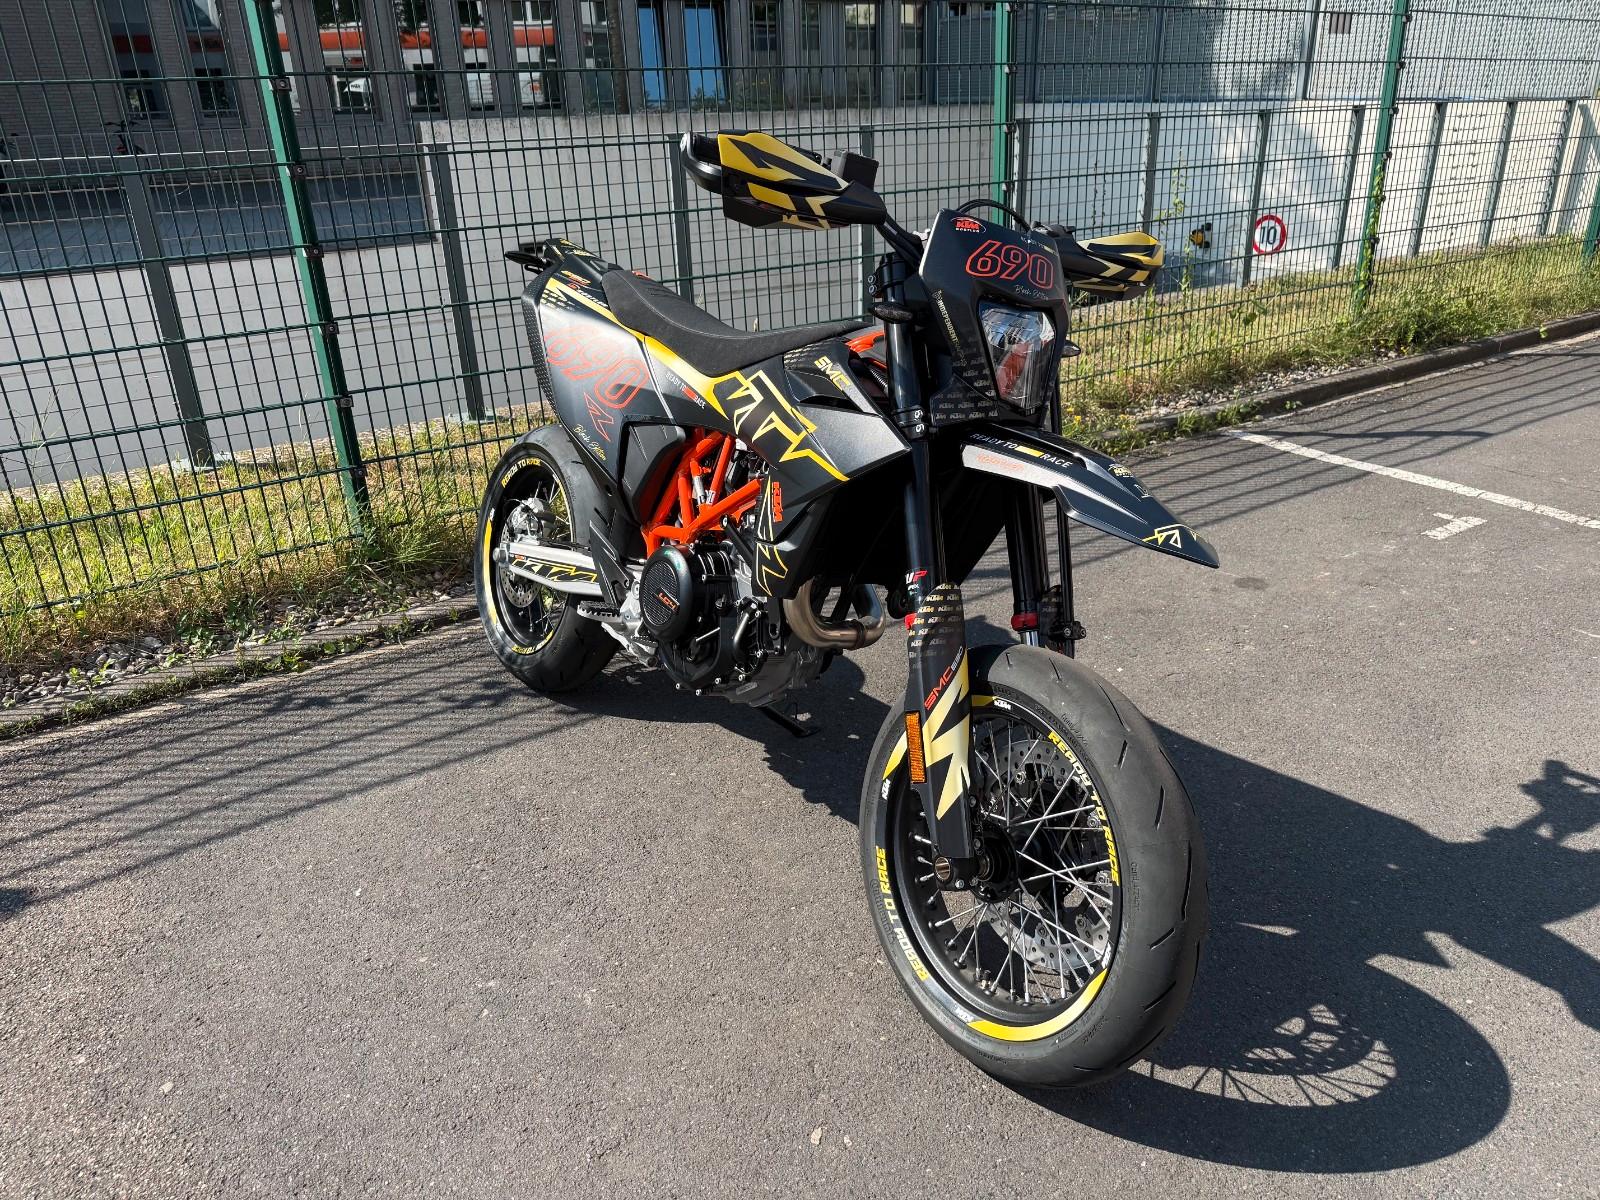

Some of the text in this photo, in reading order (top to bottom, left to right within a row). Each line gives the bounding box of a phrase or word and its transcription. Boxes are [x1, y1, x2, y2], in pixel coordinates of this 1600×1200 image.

[1261, 225, 1277, 245] 10
[964, 239, 1054, 290] 690
[543, 324, 651, 410] 690
[814, 355, 851, 391] SMC
[969, 433, 1004, 446] READY
[1003, 441, 1018, 450] TO
[1039, 453, 1073, 469] RACE
[924, 666, 953, 710] SMC
[1047, 730, 1092, 787] READY
[1091, 790, 1107, 821] TO
[1102, 825, 1120, 887] RACE
[876, 845, 929, 982] READY TO RACE
